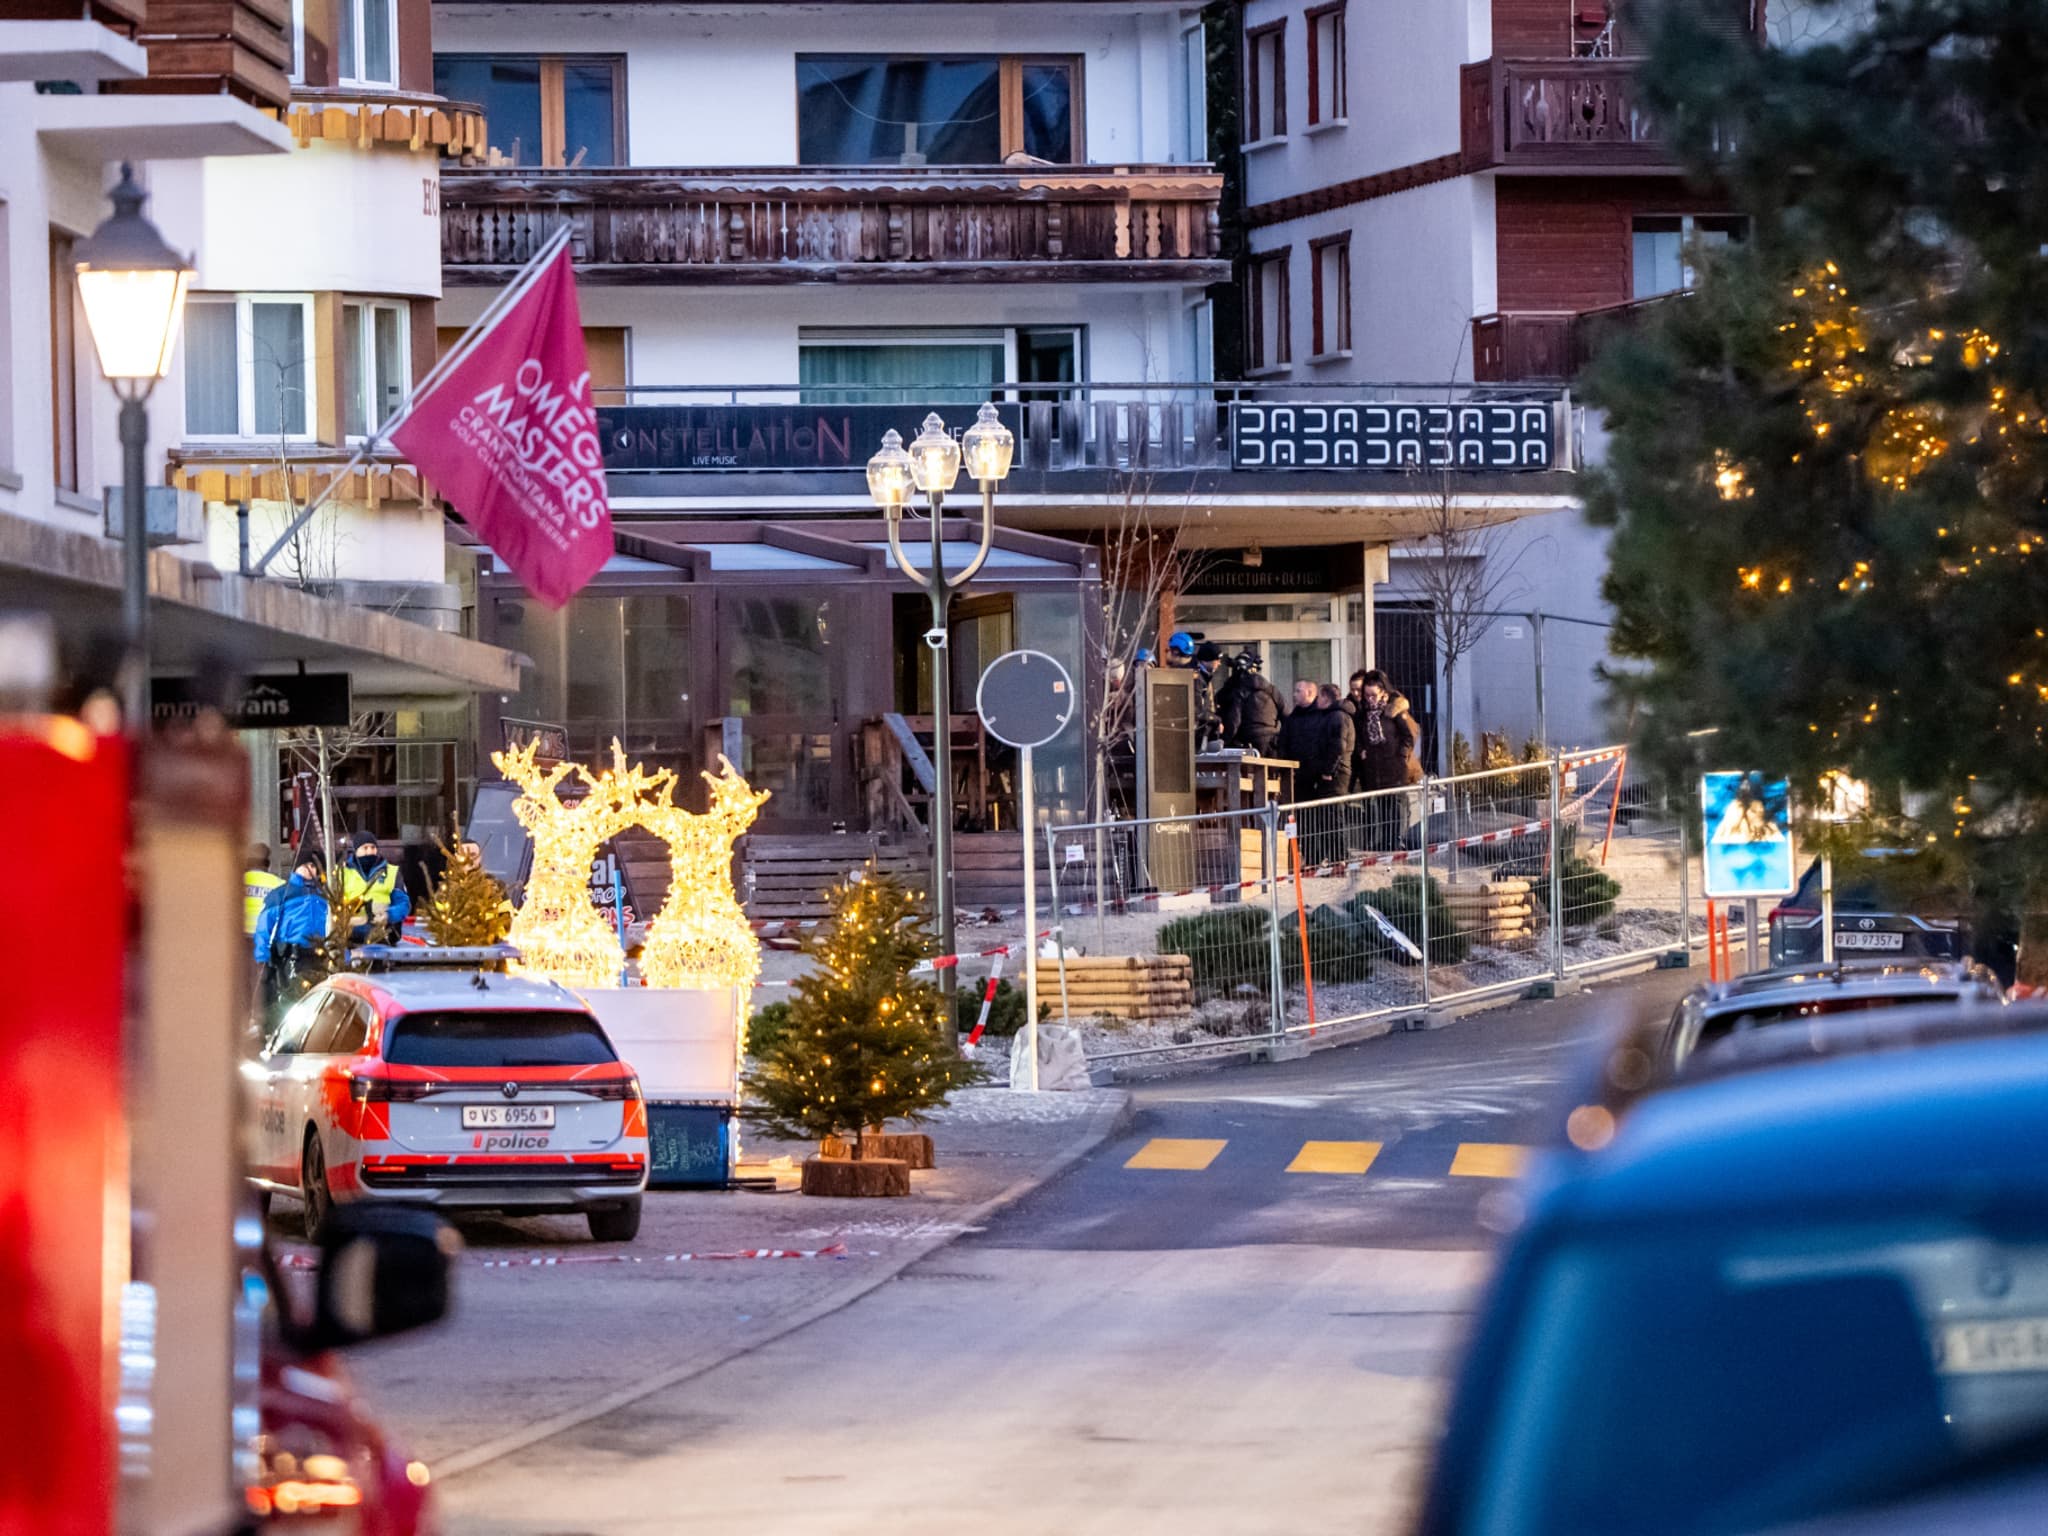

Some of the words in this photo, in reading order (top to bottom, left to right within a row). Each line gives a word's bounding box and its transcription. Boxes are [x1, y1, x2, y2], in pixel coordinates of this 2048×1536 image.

[516, 358, 608, 501] OMEGA
[473, 383, 605, 529] MASTERS
[692, 455, 710, 466] LIVE
[711, 455, 738, 465] MUSIC
[481, 1108, 498, 1122] VS
[504, 1108, 537, 1122] 6956
[485, 1131, 550, 1152] police
